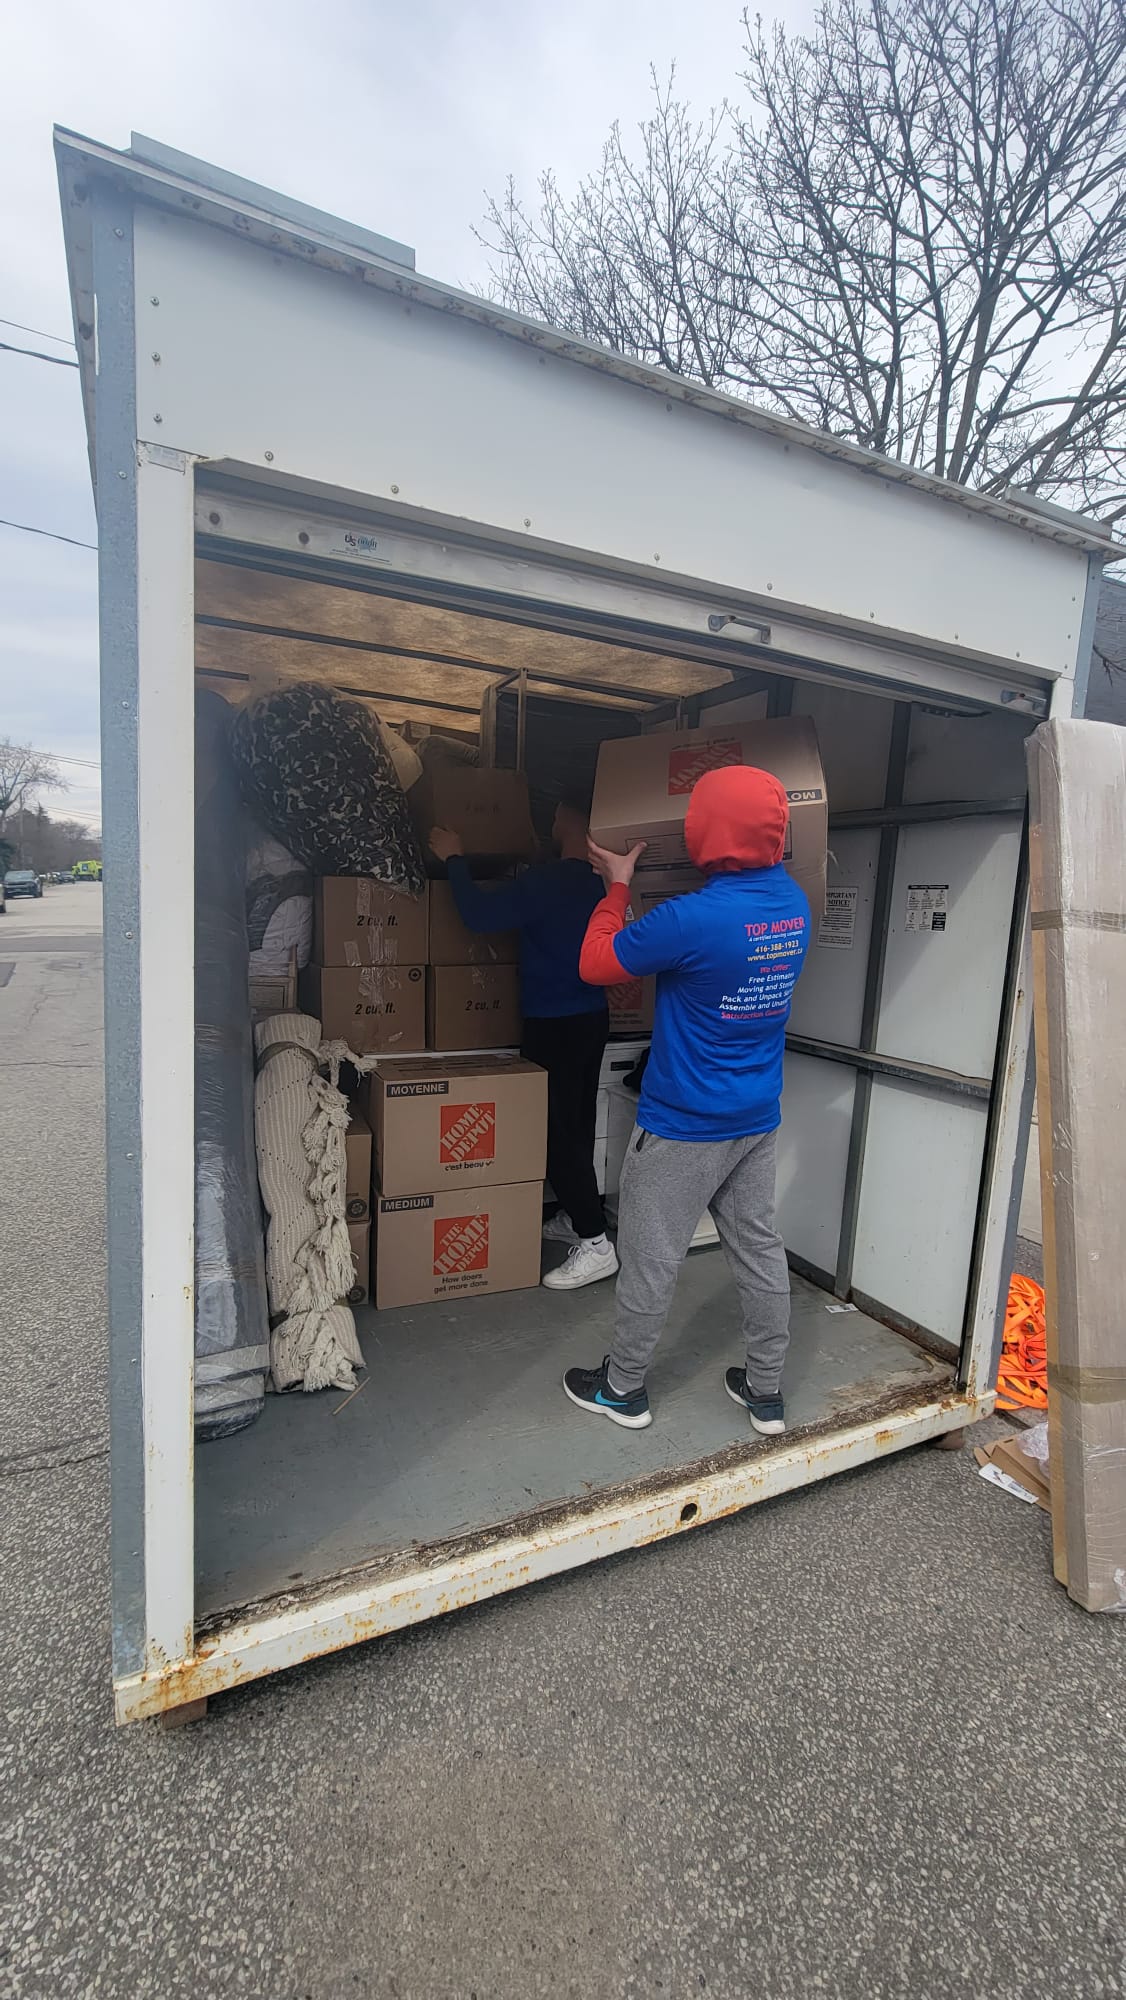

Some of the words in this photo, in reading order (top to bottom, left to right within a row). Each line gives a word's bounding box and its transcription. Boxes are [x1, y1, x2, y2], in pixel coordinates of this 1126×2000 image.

[356, 915, 365, 926] 2
[367, 916, 383, 927] cu.
[387, 915, 398, 926] ft.
[744, 923, 768, 937] TOP
[771, 916, 805, 933] MOVER
[748, 976, 765, 984] Free
[737, 985, 764, 994] Moving
[722, 995, 742, 1003] Pack
[759, 991, 782, 1001] Unpack
[355, 1003, 363, 1015] 2
[365, 1005, 382, 1015] cu.
[385, 1003, 396, 1014] ft.
[465, 1000, 473, 1011] 2
[475, 1001, 489, 1011] cu.
[492, 1000, 501, 1009] ft.
[719, 1003, 756, 1011] Assemble
[390, 1083, 446, 1096] MOYENNE
[440, 1103, 483, 1150] HOME
[449, 1110, 495, 1161] DEPOT
[445, 1162, 462, 1171] c'est
[464, 1160, 483, 1169] beau
[385, 1198, 430, 1210] MEDIUM
[440, 1223, 463, 1247] THE
[433, 1215, 488, 1274] HOME
[456, 1234, 488, 1272] DEPOT
[442, 1276, 459, 1284] How
[461, 1273, 483, 1281] doers
[434, 1285, 446, 1294] get
[449, 1283, 468, 1291] more
[469, 1280, 488, 1288] done
